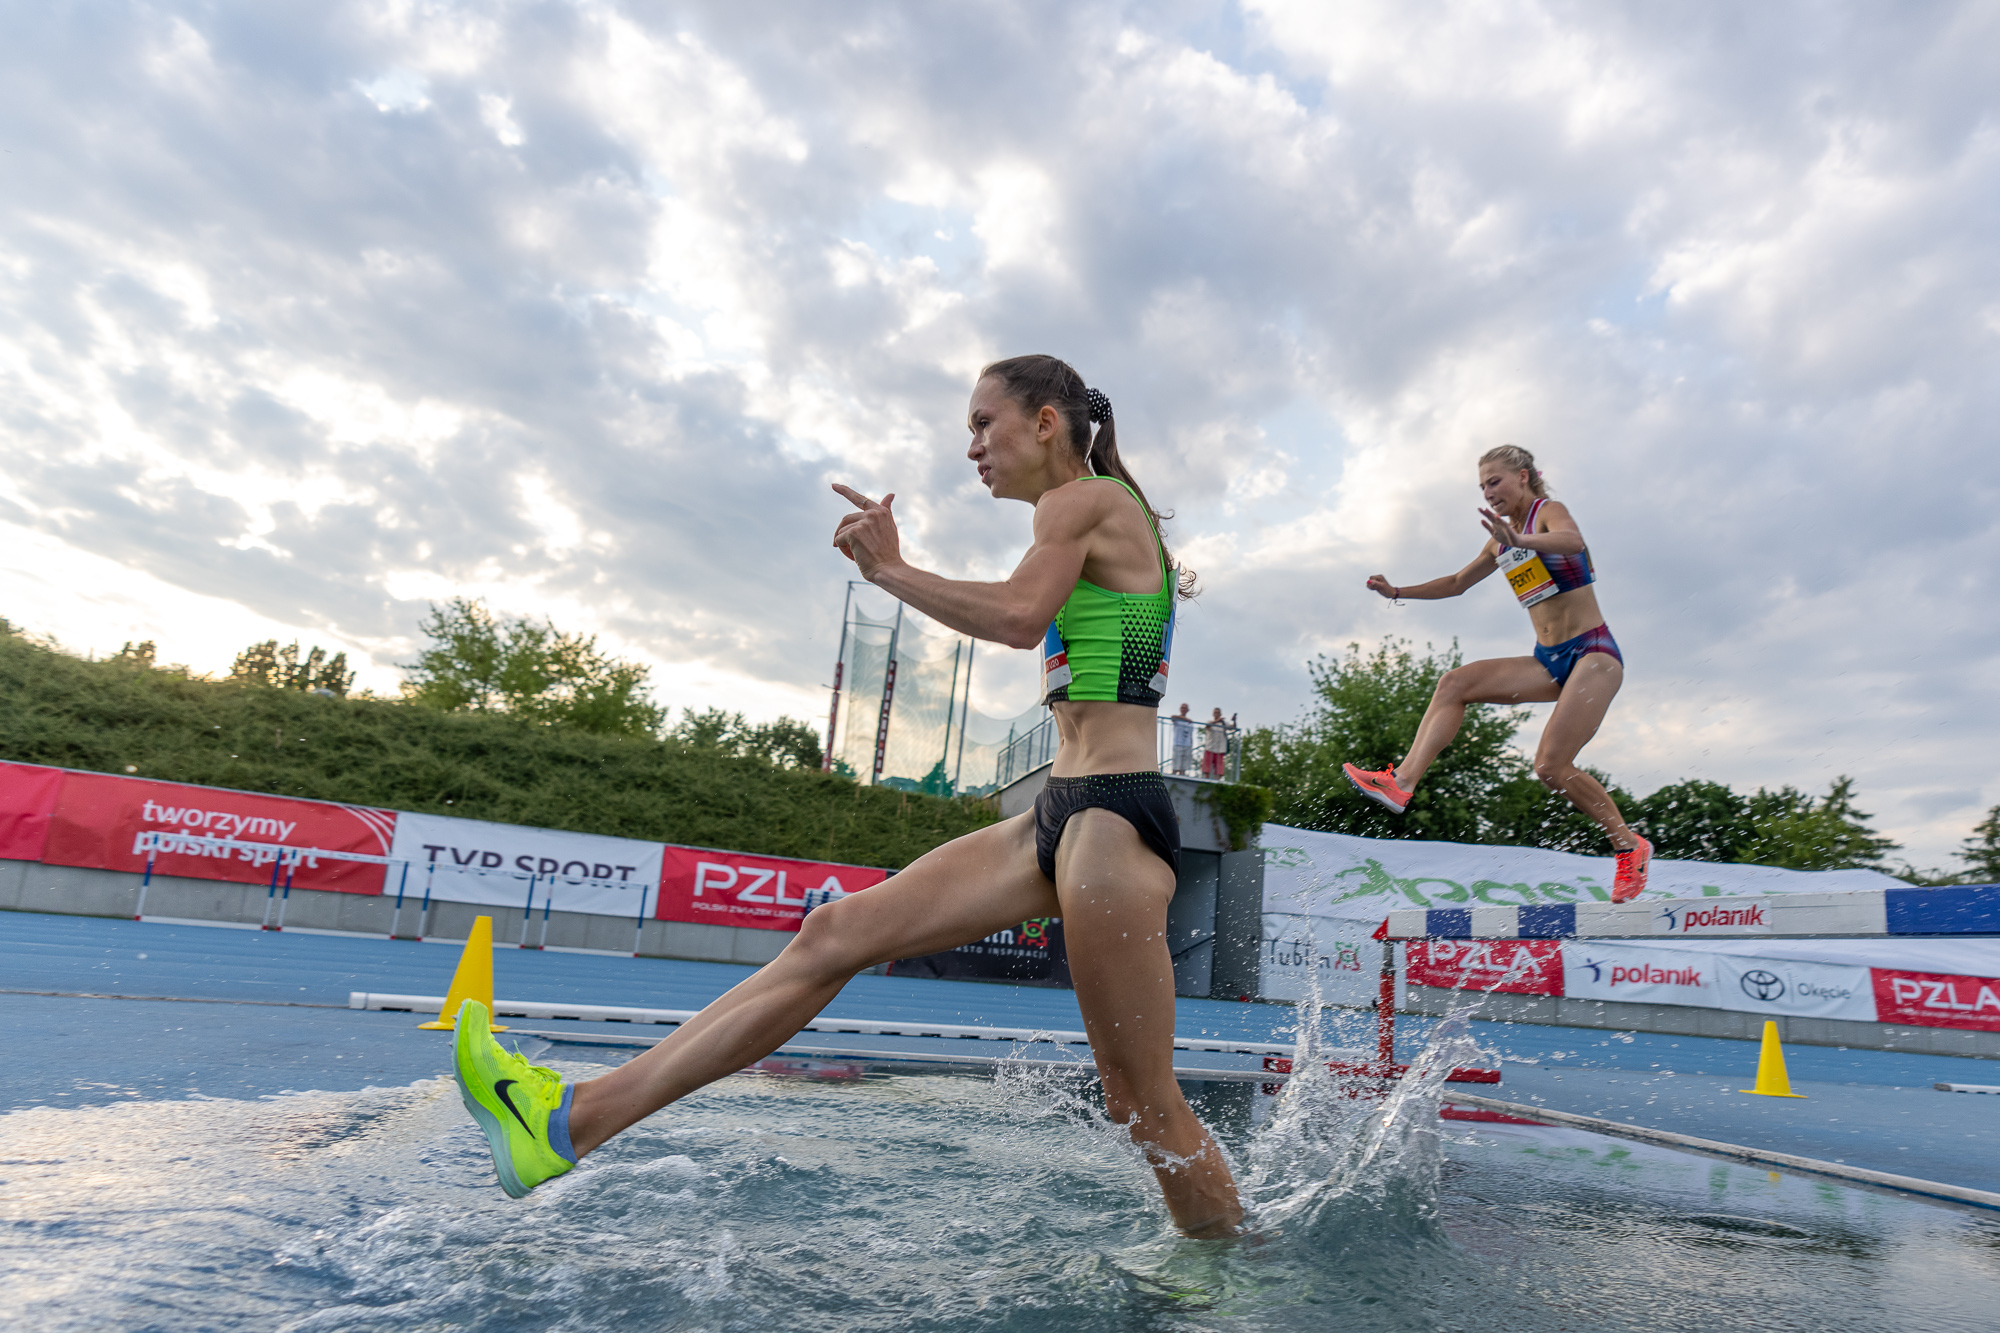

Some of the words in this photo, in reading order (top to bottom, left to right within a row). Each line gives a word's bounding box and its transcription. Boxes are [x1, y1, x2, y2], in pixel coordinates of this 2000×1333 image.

[1509, 567, 1536, 590] PERYT
[142, 799, 297, 842] tworzymy
[422, 844, 503, 876] TVP
[514, 855, 636, 890] SPORT
[1684, 904, 1765, 931] polanik
[987, 947, 1048, 959] INSPIRACJI
[1427, 940, 1542, 975] PZLA
[1610, 963, 1702, 987] polanik
[1892, 977, 2000, 1012] PZLA
